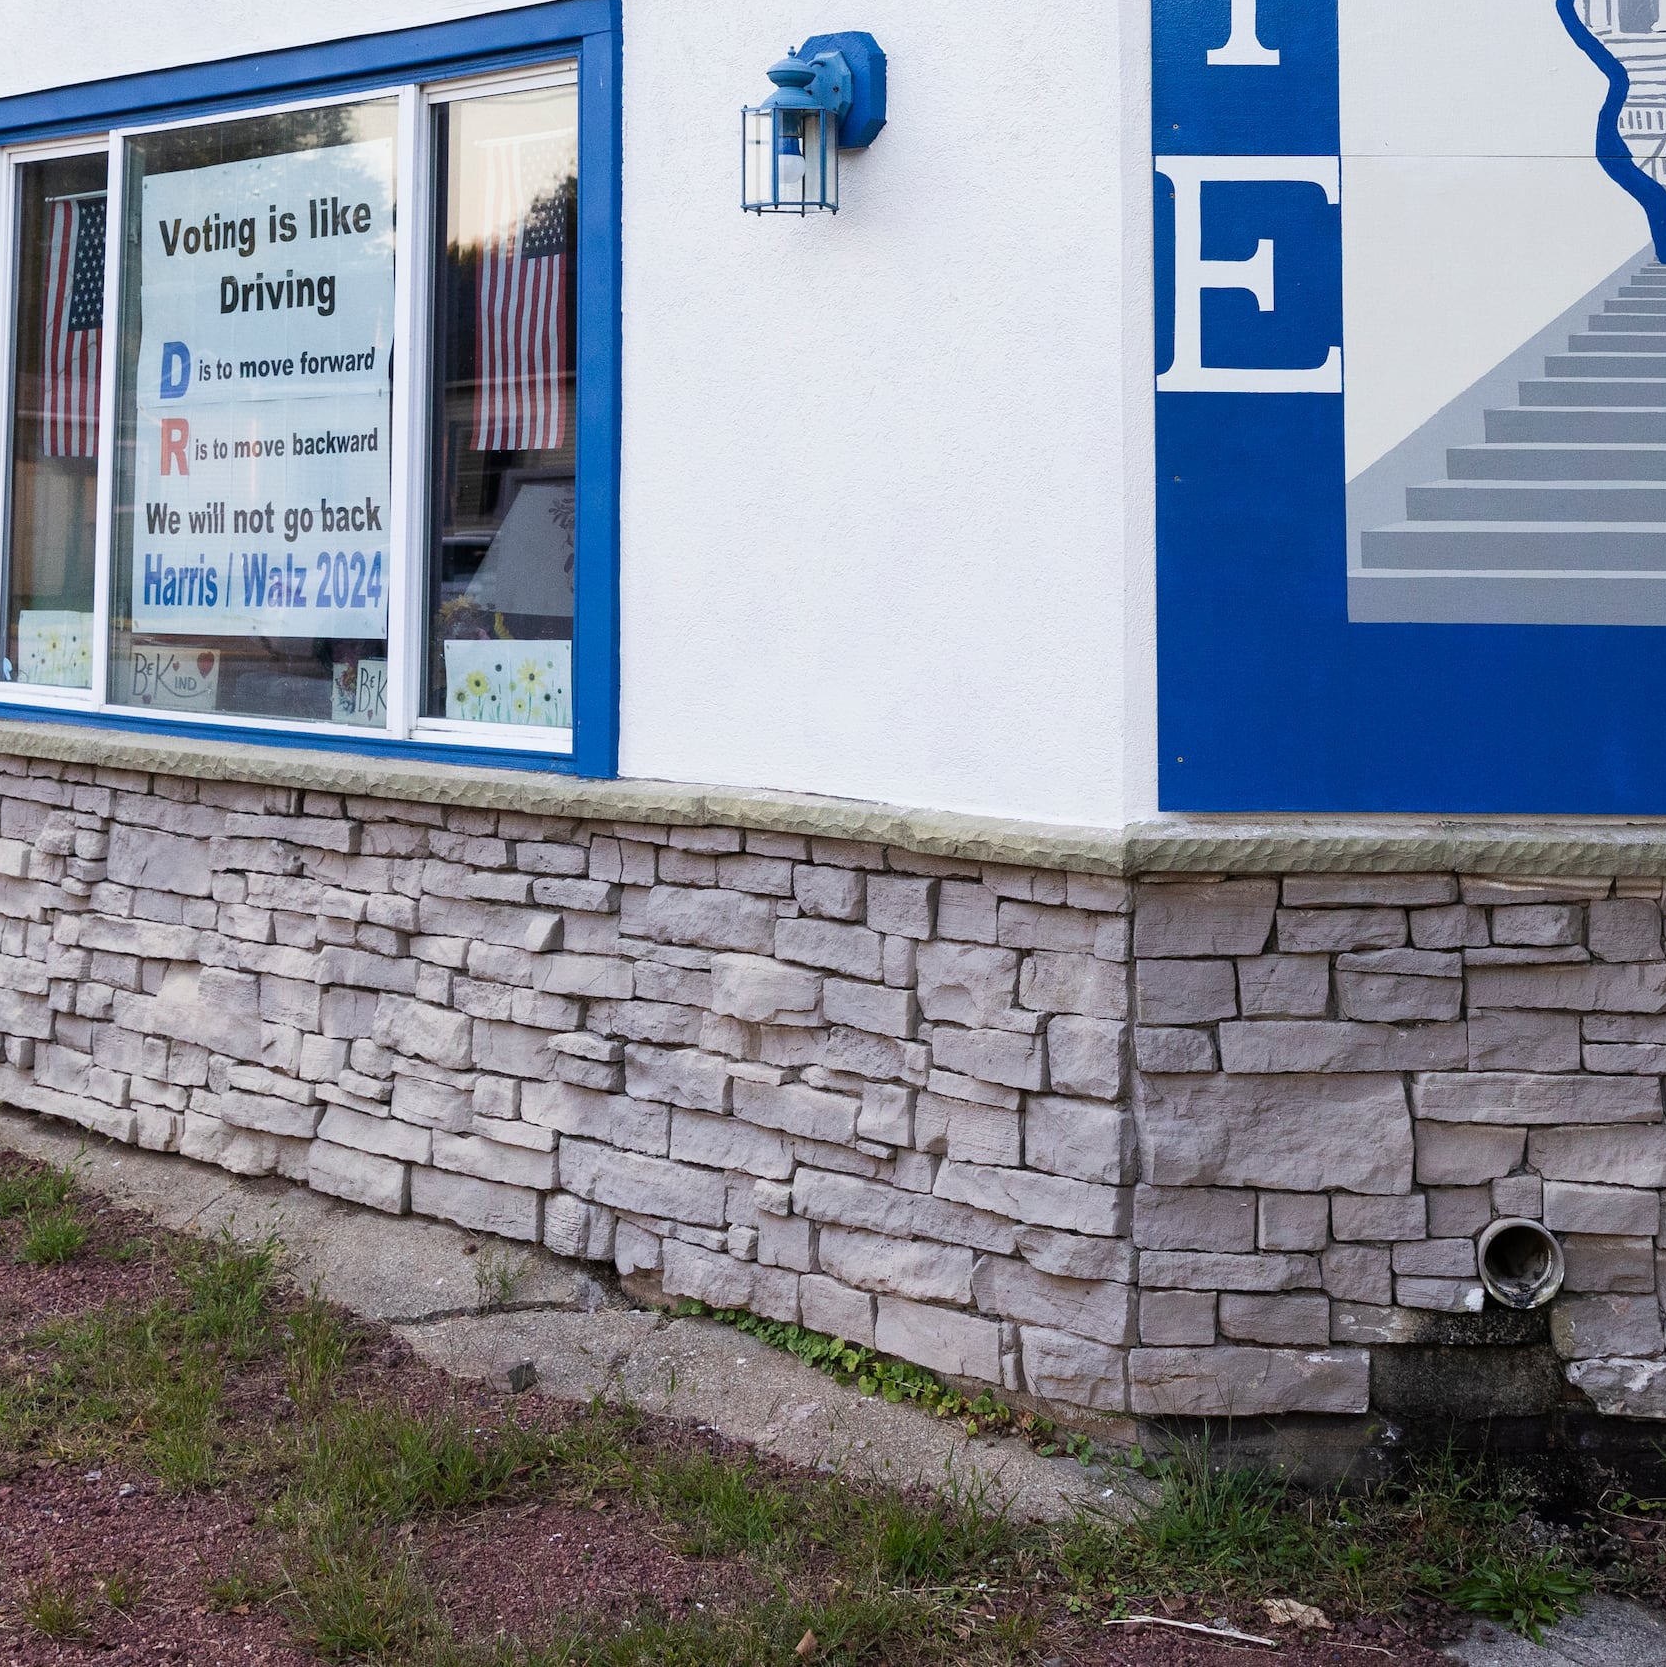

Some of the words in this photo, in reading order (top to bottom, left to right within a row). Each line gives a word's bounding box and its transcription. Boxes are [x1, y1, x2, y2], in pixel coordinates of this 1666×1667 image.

[159, 213, 256, 258] Voting
[269, 204, 297, 243] is
[309, 196, 372, 239] like
[220, 269, 336, 317] Driving
[159, 341, 191, 399] D
[198, 359, 211, 382] is
[216, 358, 232, 380] to
[239, 358, 294, 379] move
[300, 346, 376, 375] forward
[160, 418, 190, 476] R
[195, 438, 208, 461] is
[213, 438, 228, 459] to
[234, 438, 285, 458] move
[292, 427, 379, 456] backward
[146, 502, 180, 535] We
[188, 501, 225, 534] will
[233, 500, 275, 534] not
[284, 507, 313, 543] go
[321, 497, 382, 532] back
[144, 552, 218, 607] Harris
[225, 552, 233, 608] /
[242, 552, 307, 608] Walz
[315, 551, 382, 609] 2024
